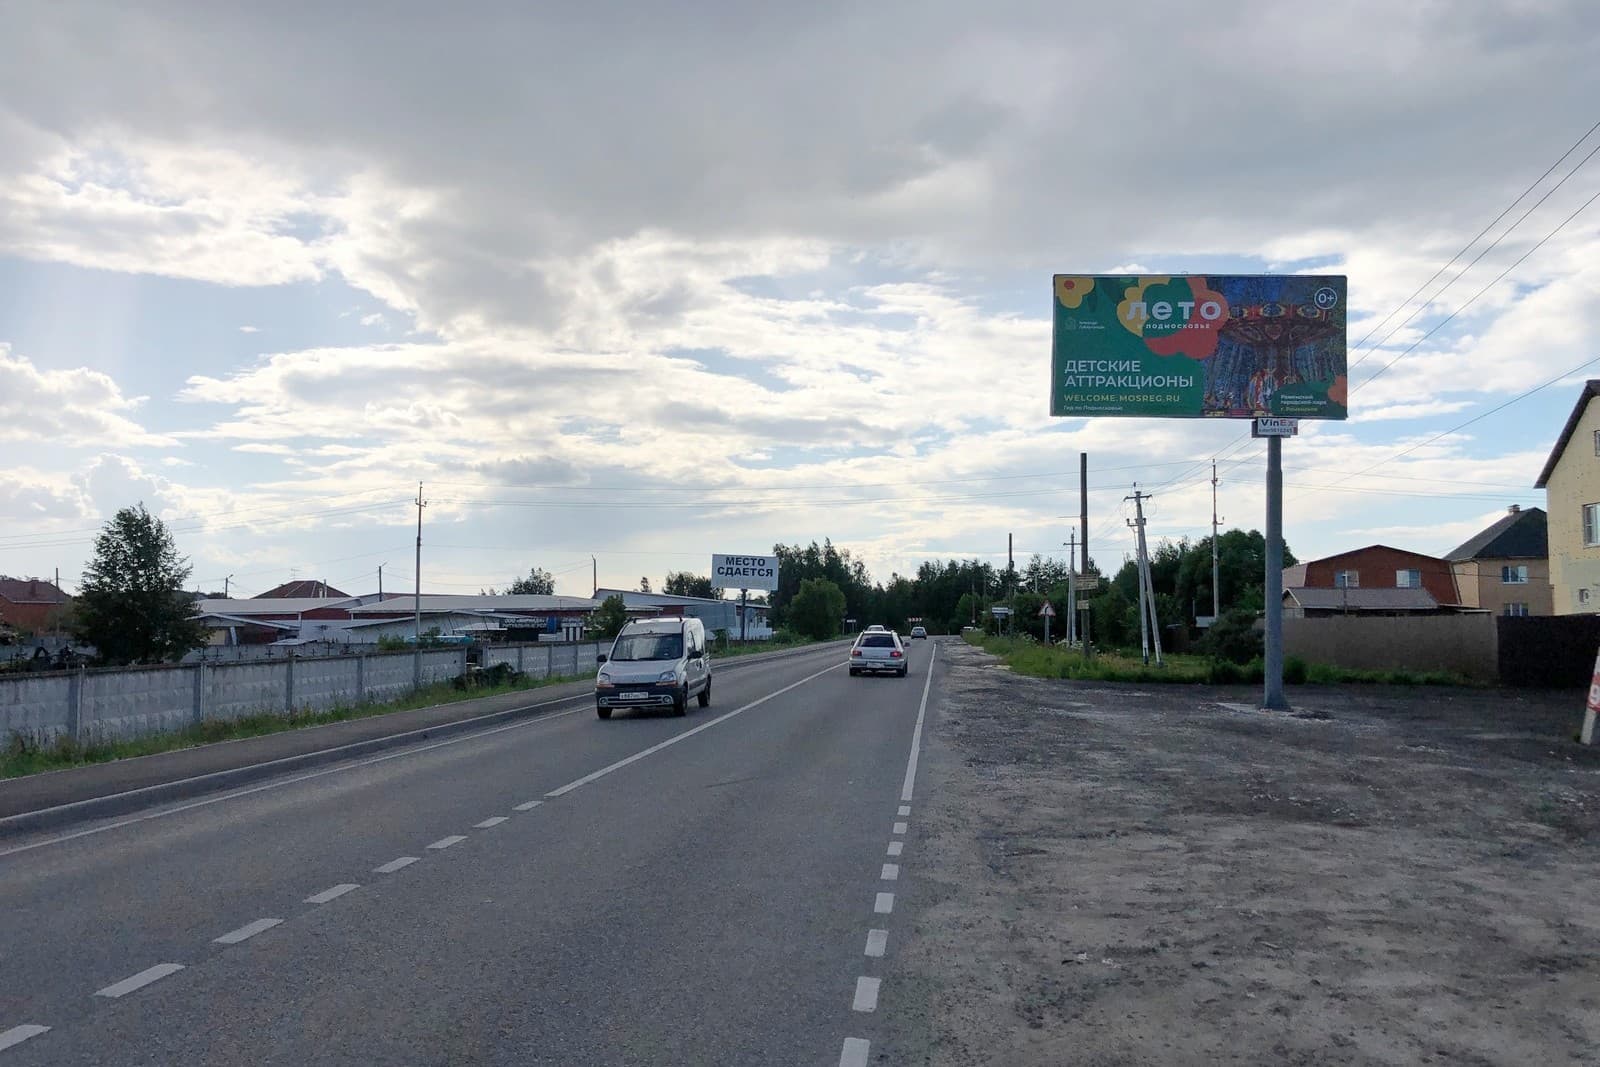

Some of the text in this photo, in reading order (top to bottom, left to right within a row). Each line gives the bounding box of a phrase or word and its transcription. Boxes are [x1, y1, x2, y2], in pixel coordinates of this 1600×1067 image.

[1318, 293, 1334, 304] 0+
[1064, 360, 1141, 374] ДЕТСКИЕ
[1064, 376, 1193, 390] АТТРАКЦИОНЫ
[1064, 394, 1181, 403] WELCOME.MOSREG.RU
[726, 556, 766, 567] МЕСТО
[717, 566, 773, 578] СДАЕТСЯ
